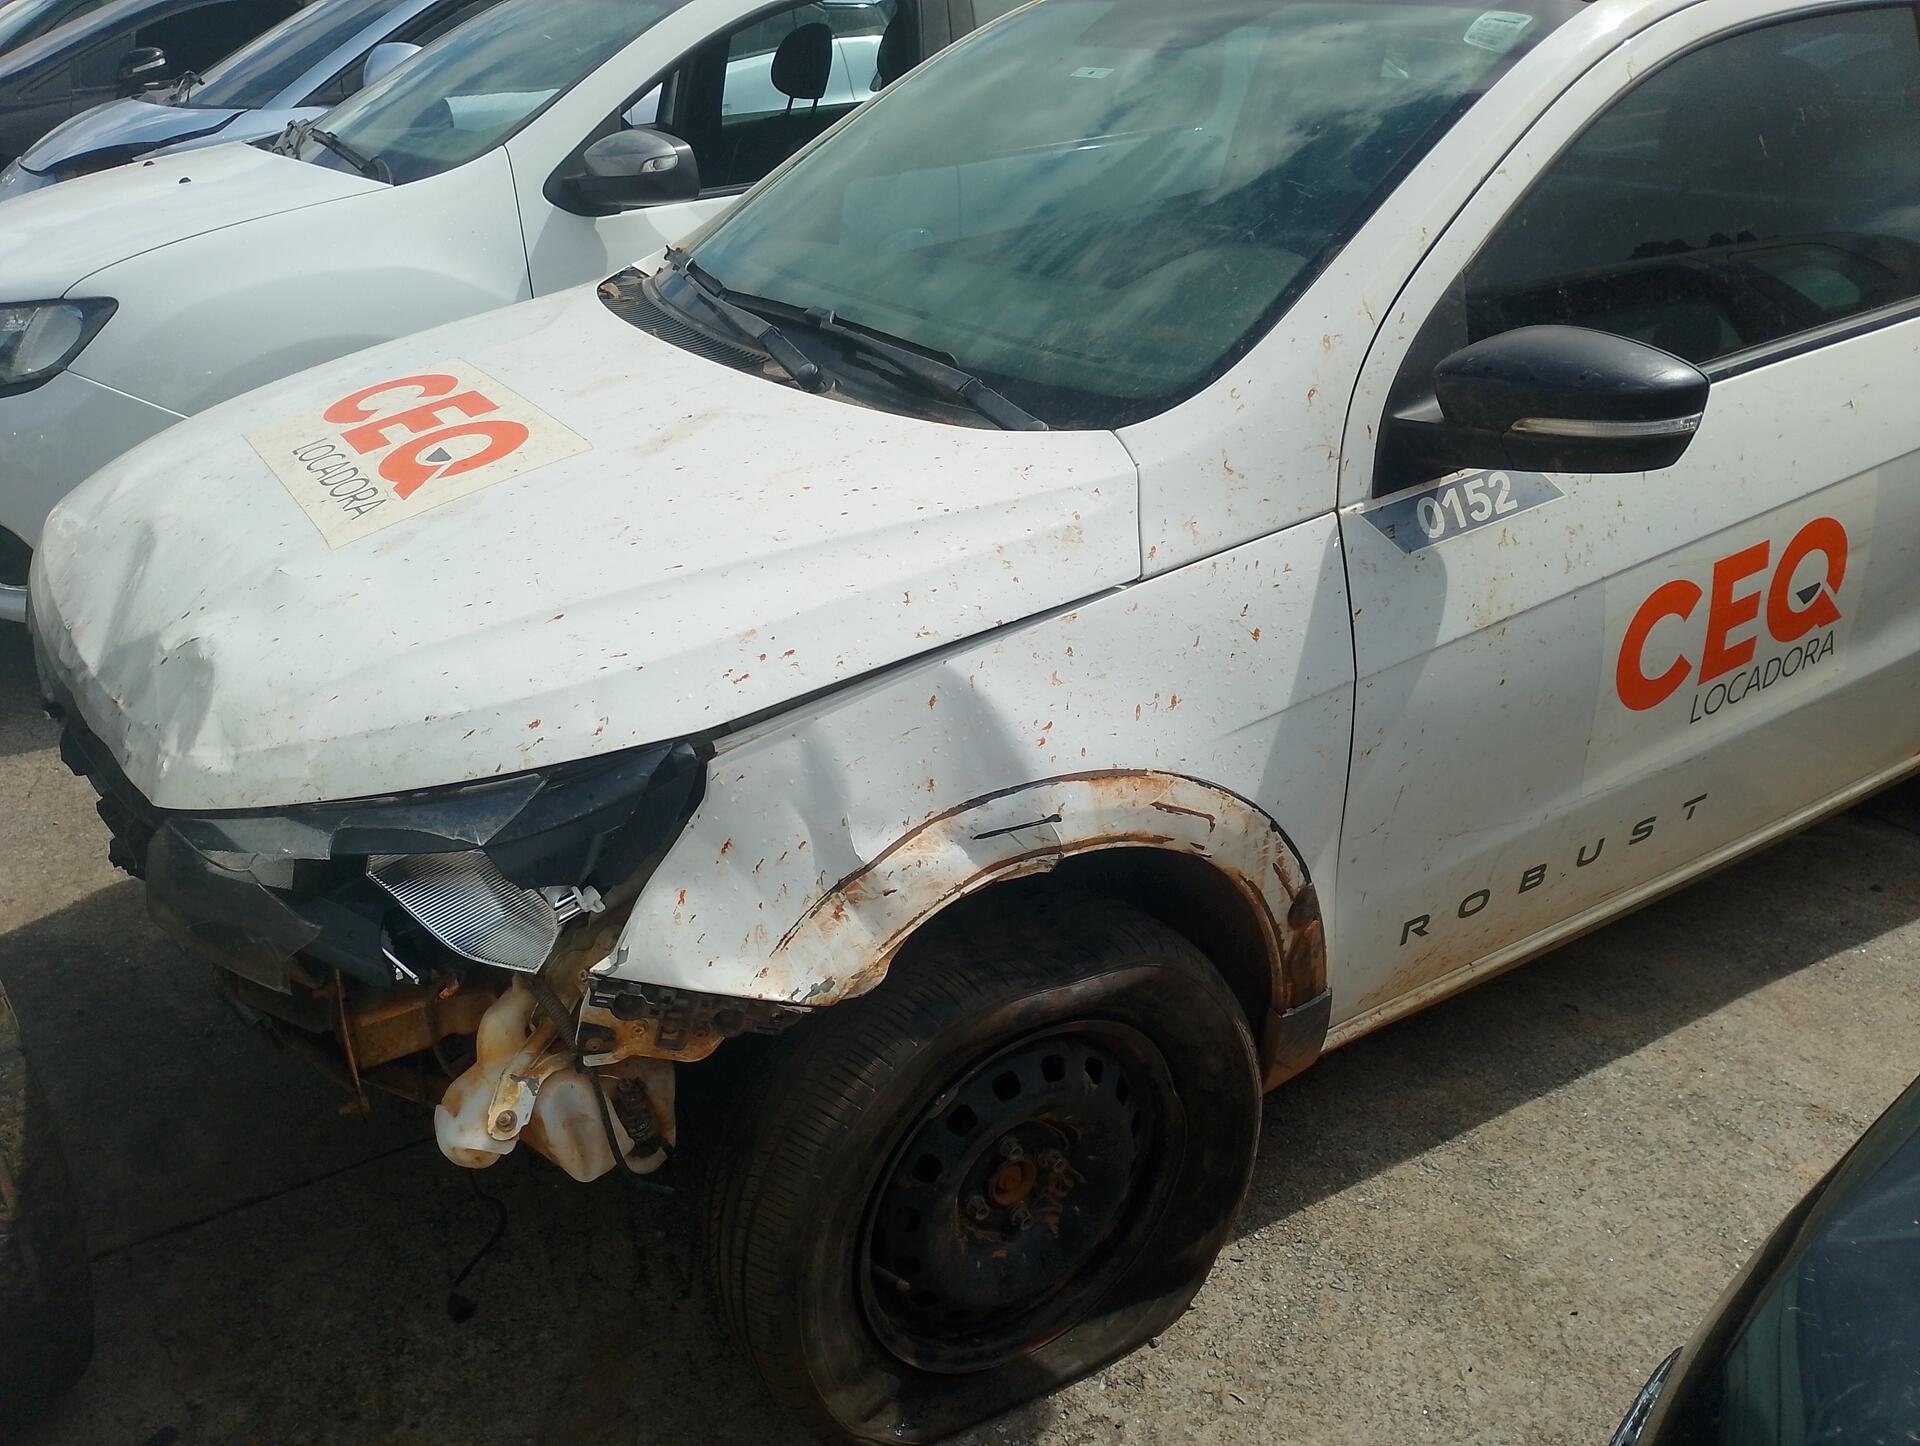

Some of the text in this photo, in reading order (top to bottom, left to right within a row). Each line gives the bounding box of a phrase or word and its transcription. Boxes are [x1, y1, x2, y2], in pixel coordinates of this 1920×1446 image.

[292, 438, 387, 520] LOCADORA
[323, 374, 529, 500] CEQ
[1416, 472, 1518, 538] 0152
[1616, 517, 1848, 711] CEQ
[1690, 630, 1834, 724] LOCADORA
[1400, 793, 1707, 946] ROBUST
